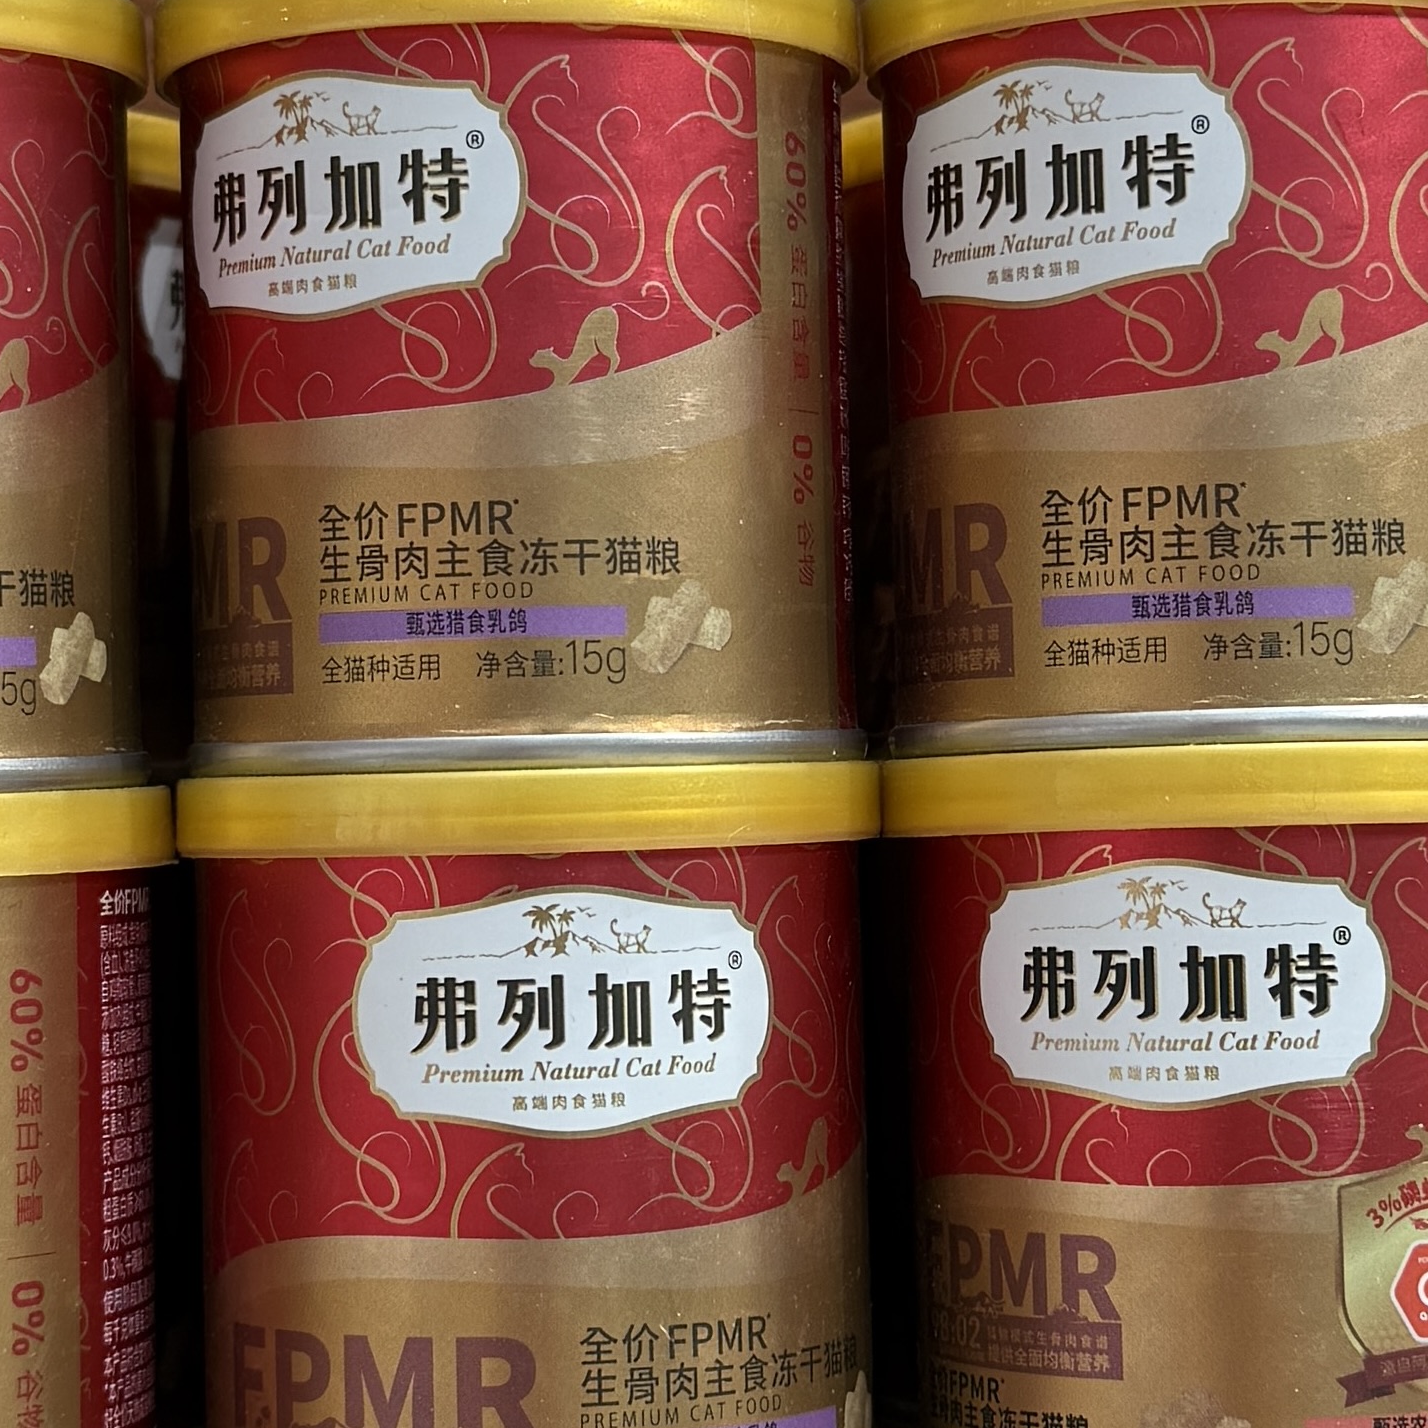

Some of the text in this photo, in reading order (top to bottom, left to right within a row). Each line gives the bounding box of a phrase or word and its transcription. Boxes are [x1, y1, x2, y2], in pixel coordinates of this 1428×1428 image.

[213, 147, 469, 253] 弗列加特
[926, 133, 1194, 243] 弗列加特
[218, 233, 450, 279] Premium Natural Cat Food
[986, 259, 1080, 285] 高端肉食猫粮
[268, 273, 358, 299] 高端肉食猫粮
[319, 501, 514, 542] 全价FPMR
[1040, 483, 1241, 528] 全价FPMR
[319, 536, 680, 583] 生骨肉主食冻干猫粮
[1041, 518, 1406, 568] 生骨肉主食冻干猫粮
[406, 610, 527, 636] 甄选猎食乳鸽
[1132, 593, 1255, 619] 甄选猎食乳鸽
[322, 640, 627, 685] 全猫种适用 净含量:15g
[1043, 621, 1355, 668] 全猫种适用 净含量:15g
[1021, 943, 1337, 1023] 弗列加特
[411, 968, 731, 1054] 弗列加特
[1031, 1029, 1320, 1052] Premium Natural Cat Food
[9, 967, 45, 1227] 60% 蛋白含量
[512, 1092, 627, 1113] 高端肉食猫粮
[11, 1280, 46, 1357] 0%
[580, 1315, 767, 1366] 全价FPMR
[580, 1333, 858, 1409] 生骨肉主食冻干猫粮
